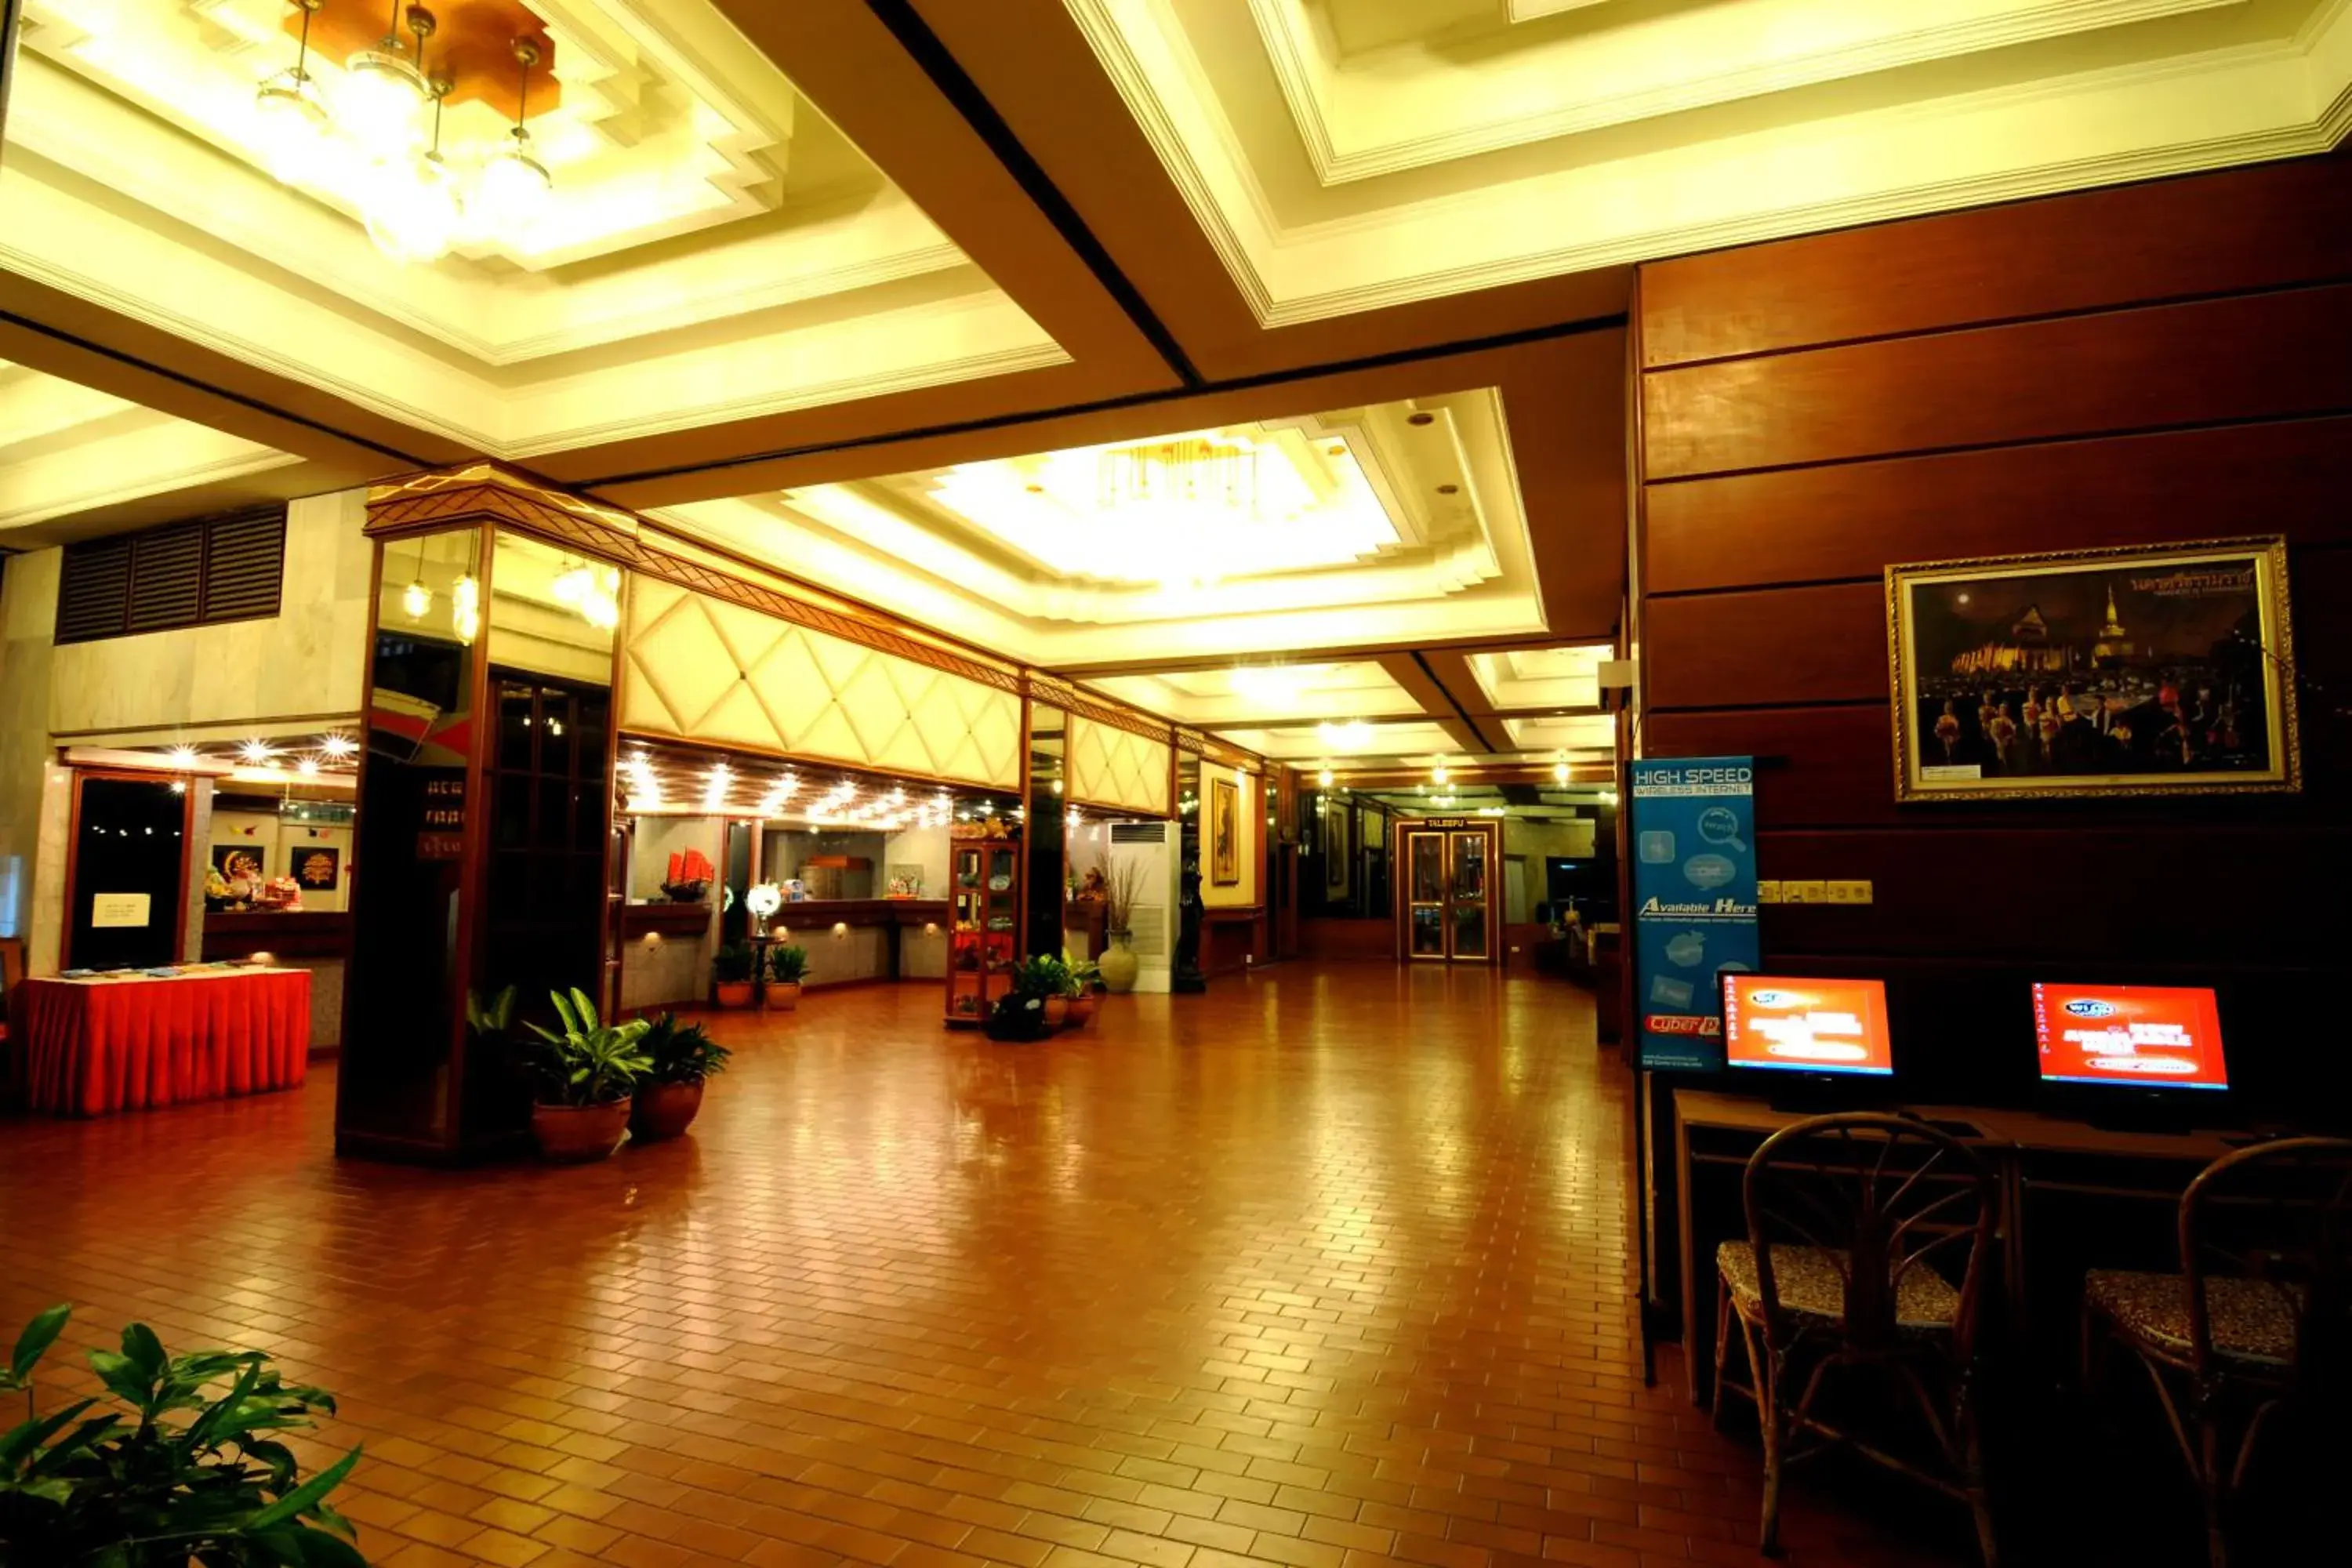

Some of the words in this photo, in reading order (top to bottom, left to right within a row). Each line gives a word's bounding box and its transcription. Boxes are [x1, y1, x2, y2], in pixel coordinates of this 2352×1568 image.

[1635, 769, 1680, 785] HIGH
[1686, 768, 1751, 784] SPEED
[1636, 786, 1692, 795] WIRELESS
[1695, 784, 1751, 794] INTERNET
[1639, 896, 1710, 916] Available
[1715, 898, 1756, 913] Here
